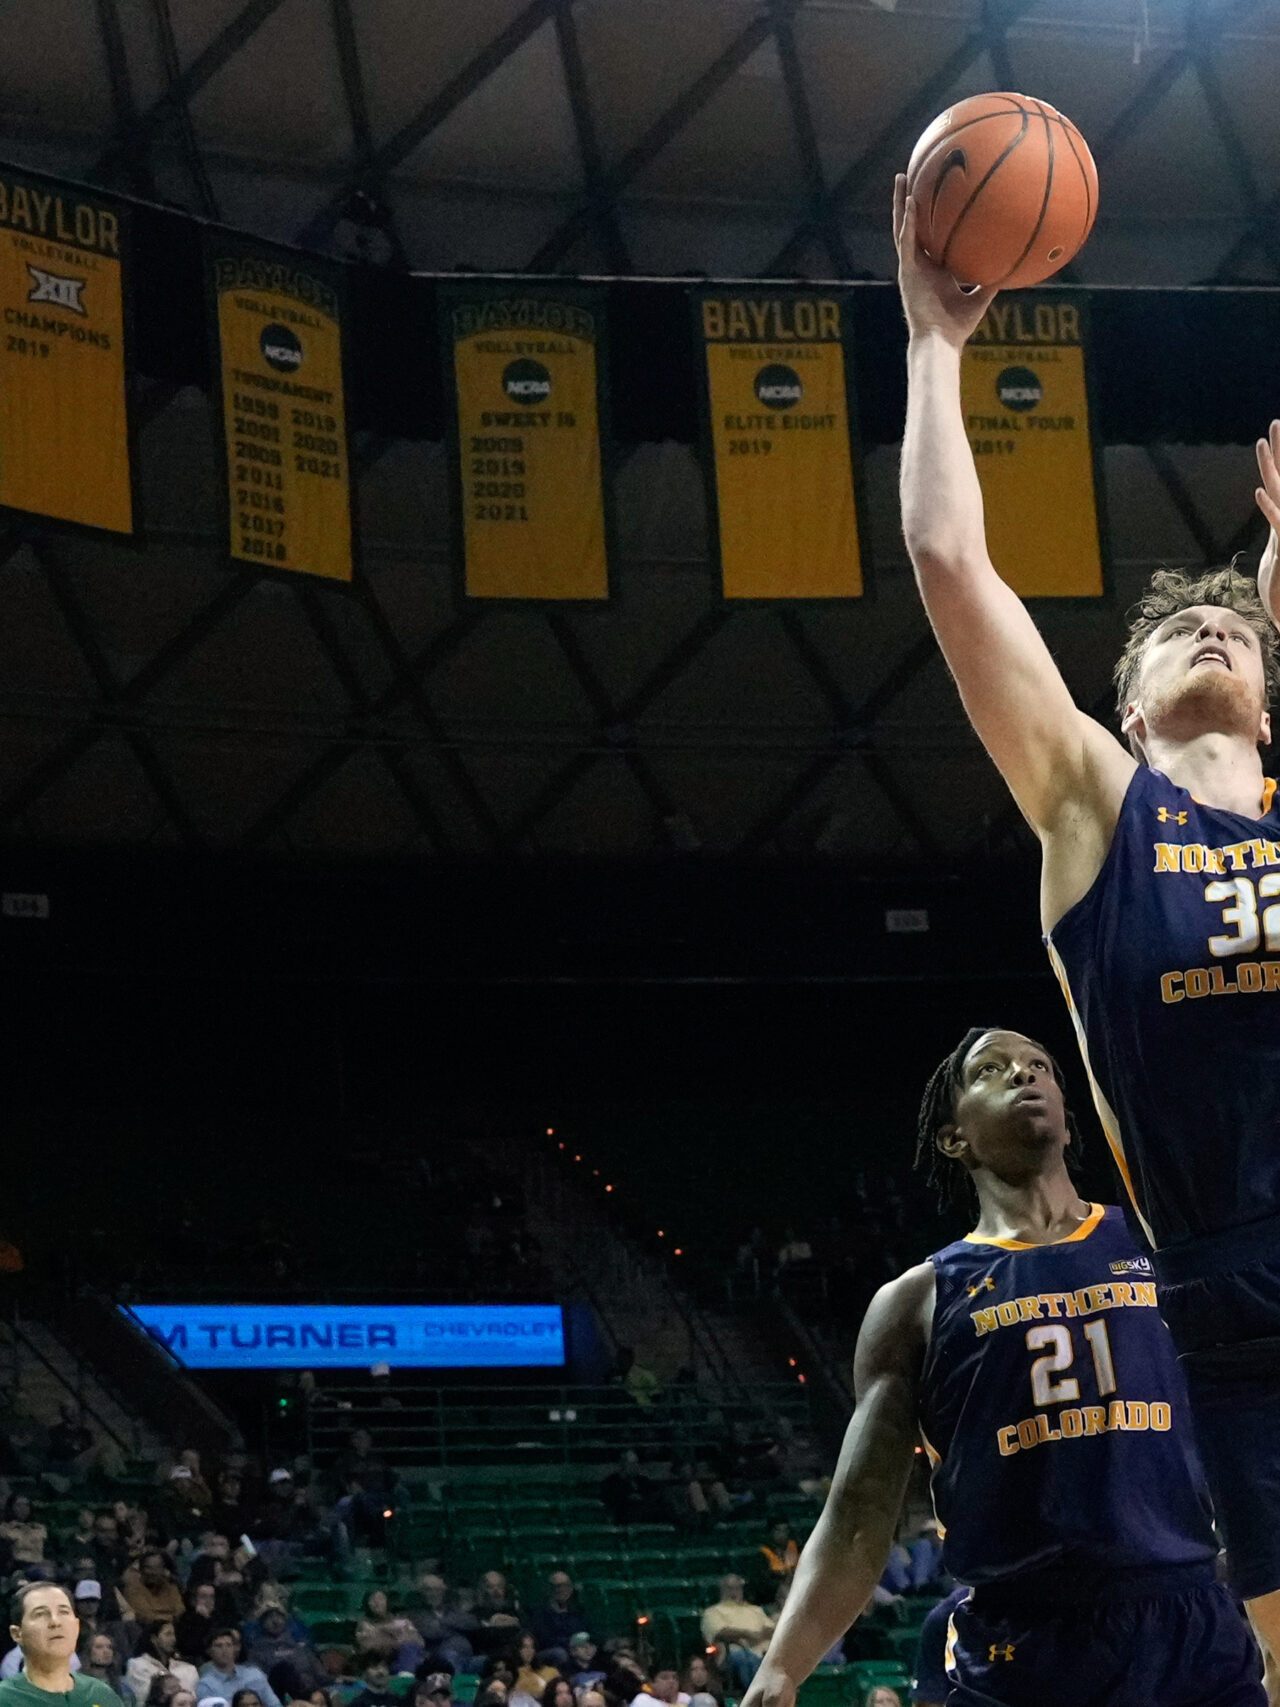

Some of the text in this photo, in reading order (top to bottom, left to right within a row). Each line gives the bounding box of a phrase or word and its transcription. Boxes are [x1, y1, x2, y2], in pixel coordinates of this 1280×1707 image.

[4, 307, 111, 350] CHAMPIONS
[702, 300, 841, 340] BAYLOR
[975, 303, 1080, 341] AYLOR
[6, 334, 50, 358] 2019
[481, 412, 550, 428] SWEET
[724, 414, 836, 431] ELITE EIGHT
[968, 416, 1074, 431] FINAL FOUR
[729, 440, 772, 456] 2019
[475, 504, 528, 521] 2021
[970, 1282, 1158, 1337] NORTHERN
[200, 1323, 398, 1350] TURNER
[424, 1321, 560, 1337] CHEVROLET
[1025, 1318, 1117, 1407] 21
[996, 1401, 1171, 1456] COLORADO
